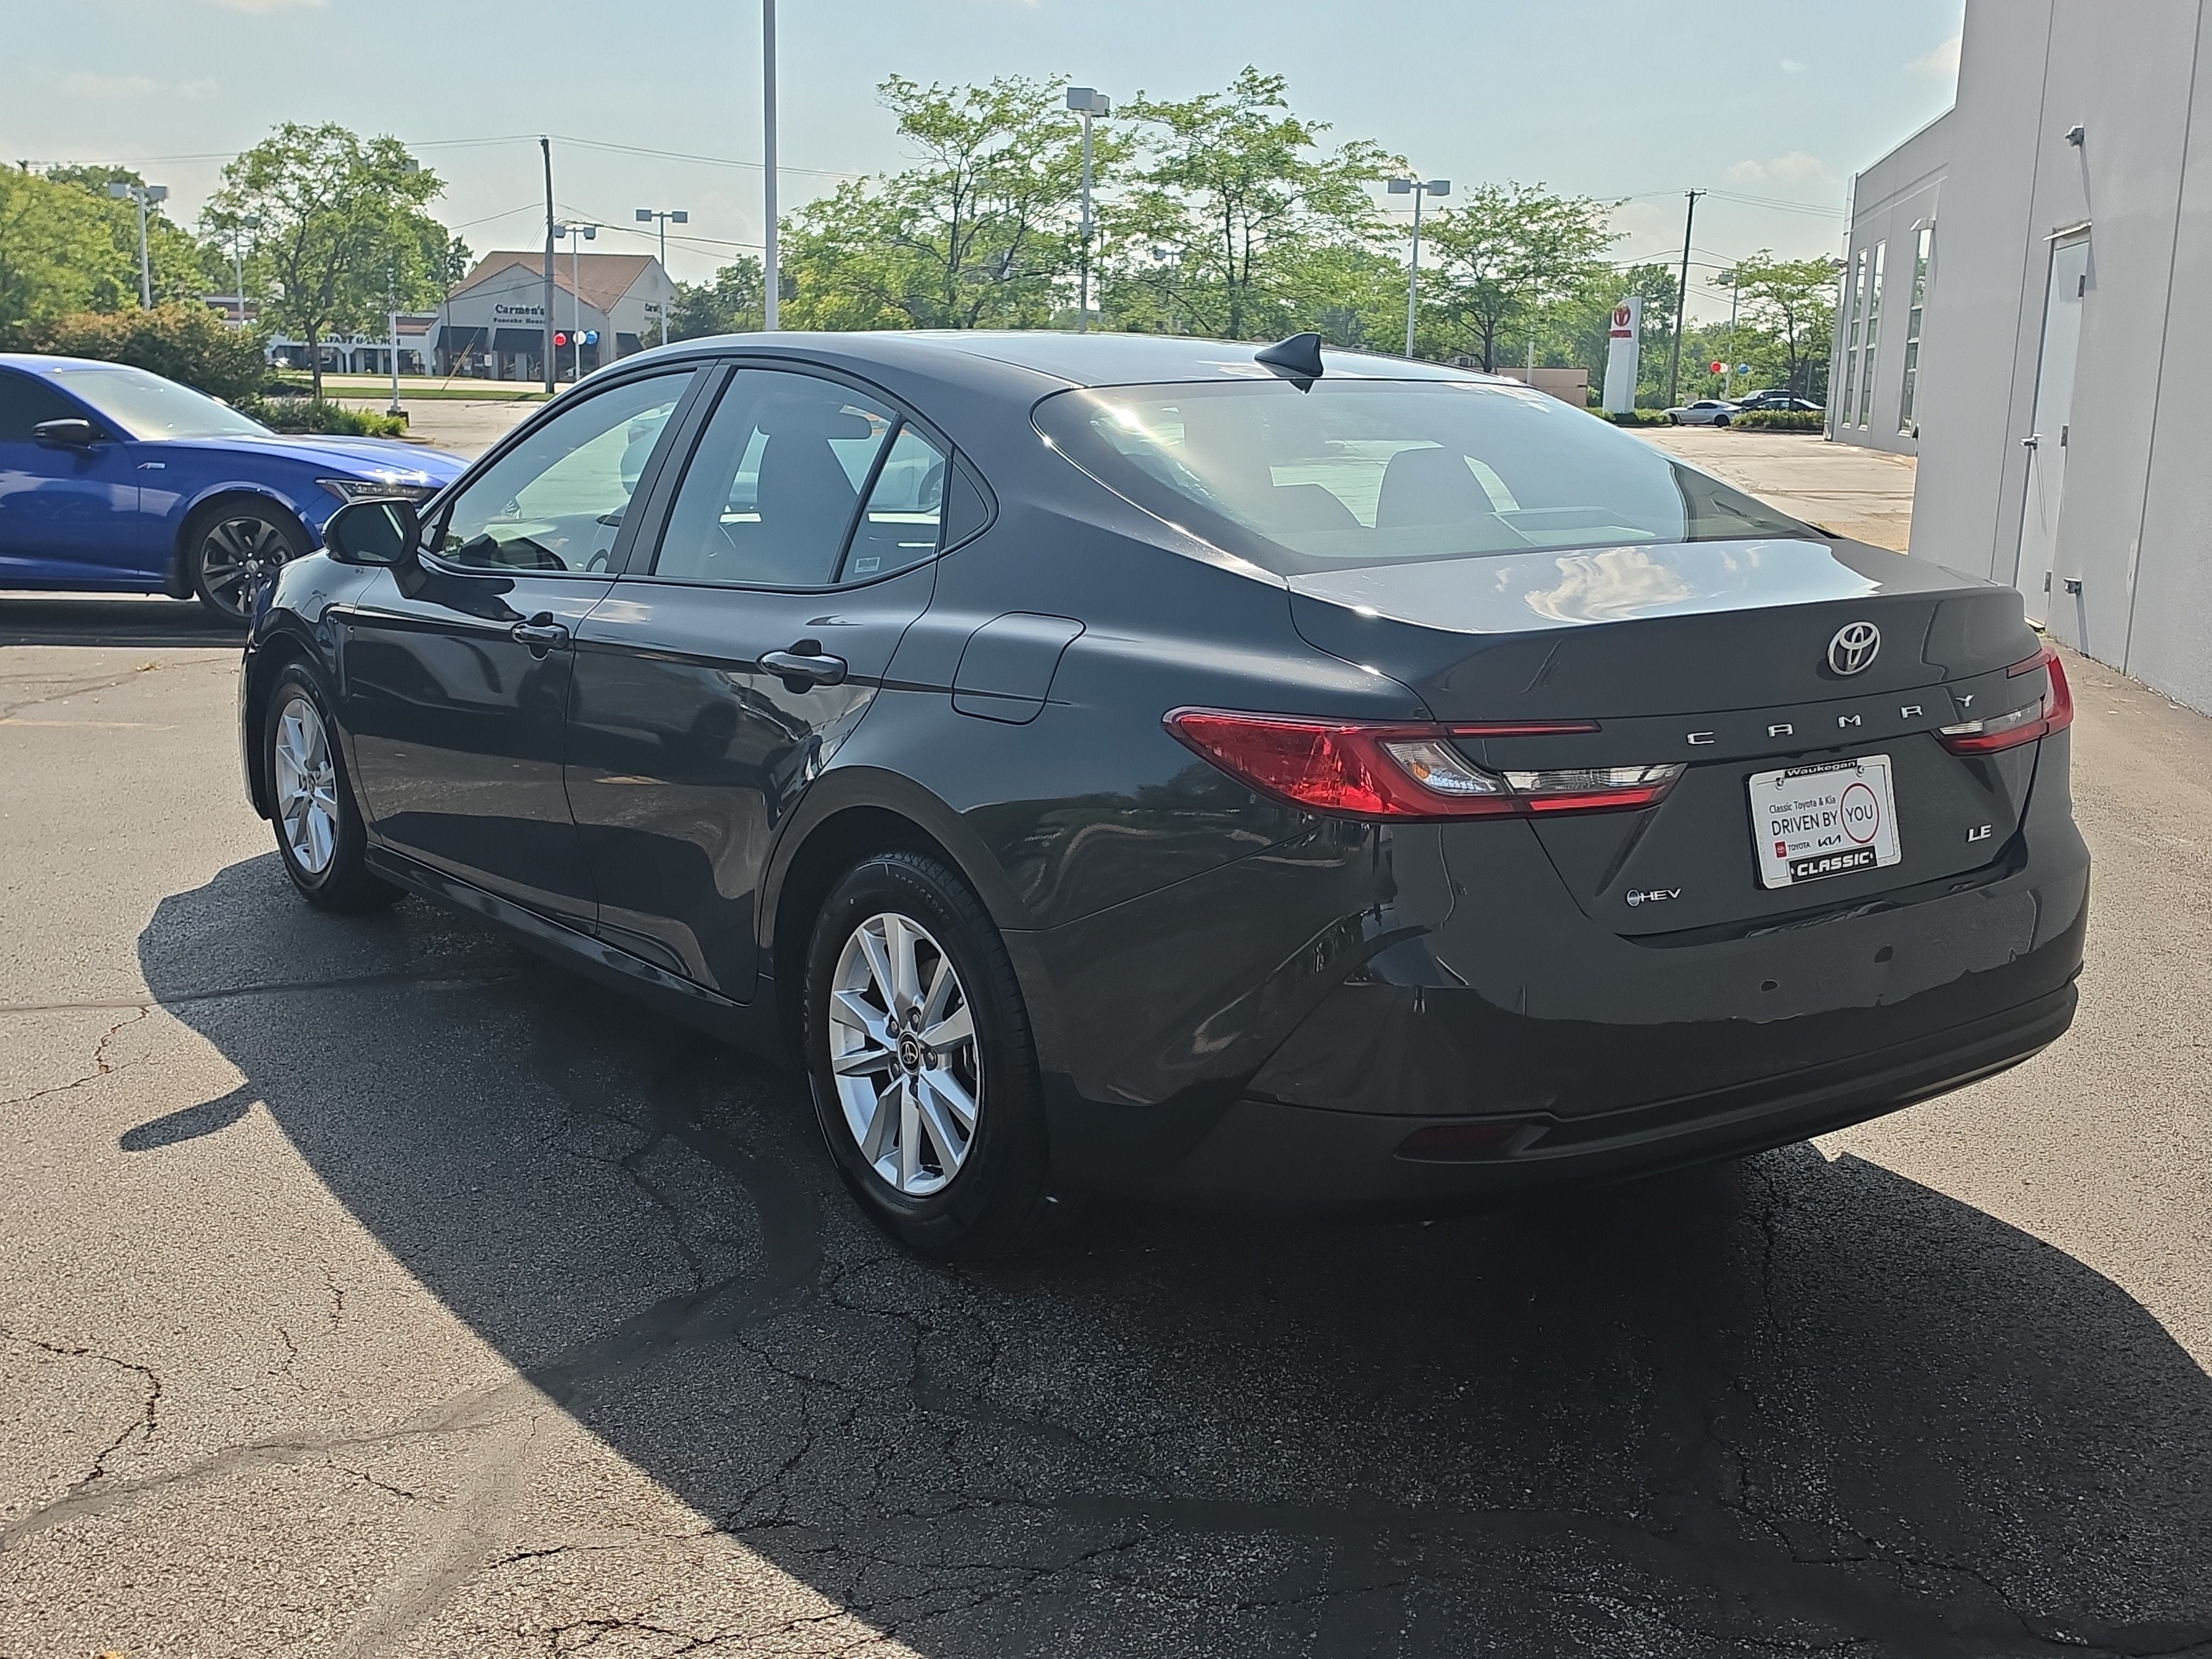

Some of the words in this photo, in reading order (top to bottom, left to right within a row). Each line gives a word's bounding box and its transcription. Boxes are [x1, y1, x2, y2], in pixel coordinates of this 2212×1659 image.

[495, 304, 544, 316] Carmen's
[1687, 694, 1975, 745] CAMRY
[1787, 762, 1855, 776] Waukegan
[1769, 803, 1792, 813] Classic
[1793, 799, 1817, 811] Toyota
[1819, 797, 1824, 806] &
[1825, 795, 1836, 805] Kia
[1771, 815, 1820, 835] DRIVEN
[1823, 810, 1838, 827] BY
[1845, 804, 1873, 823] YOU
[1967, 824, 1992, 843] LE
[1787, 842, 1811, 852] TOYOTA
[1797, 852, 1869, 876] CLASSIC
